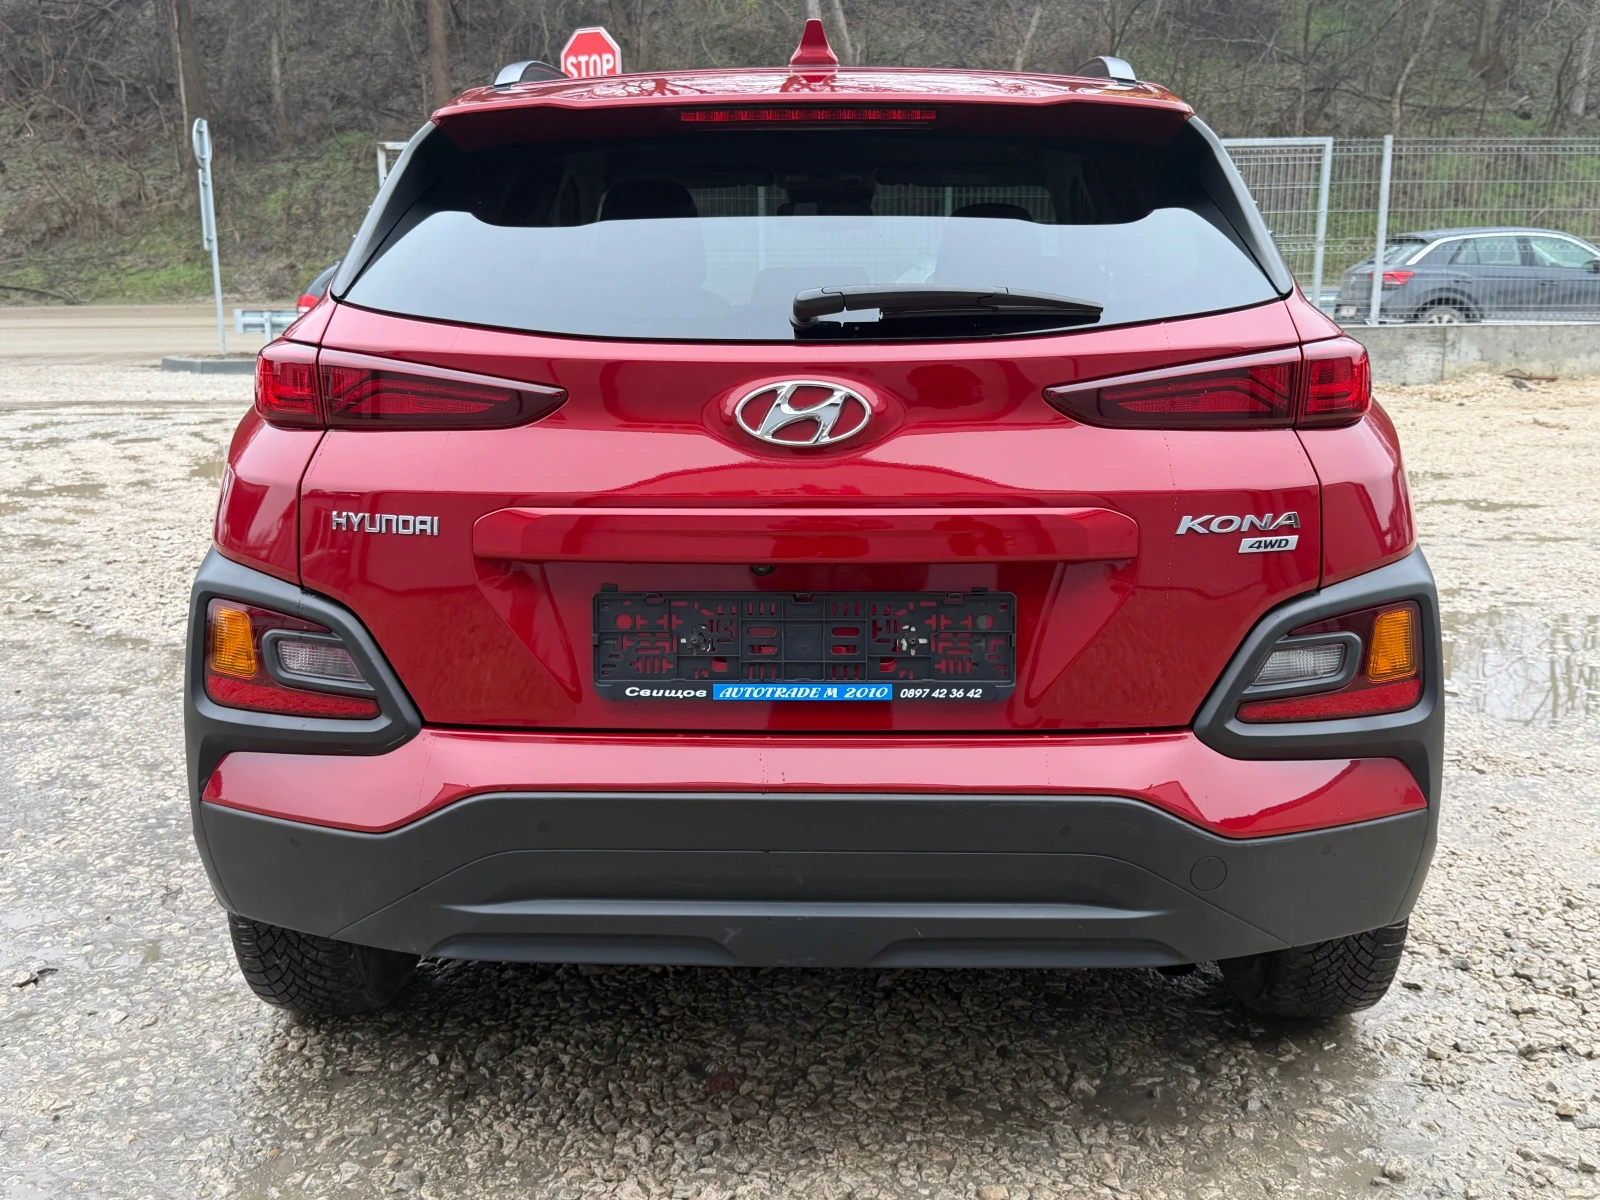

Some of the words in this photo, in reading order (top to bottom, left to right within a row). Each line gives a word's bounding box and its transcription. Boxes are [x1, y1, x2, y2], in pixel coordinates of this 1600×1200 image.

[566, 53, 615, 78] STOP
[332, 510, 440, 536] HYUNDAI
[1175, 511, 1301, 535] KONA
[1247, 538, 1290, 550] 4WD
[625, 686, 708, 699] Свищов
[719, 686, 822, 699] AUTOTRADE
[823, 686, 839, 698] M
[844, 686, 889, 699] 2010
[899, 688, 930, 699] 0897
[931, 688, 948, 699] 42
[949, 688, 965, 699] 36
[966, 688, 983, 699] 42
